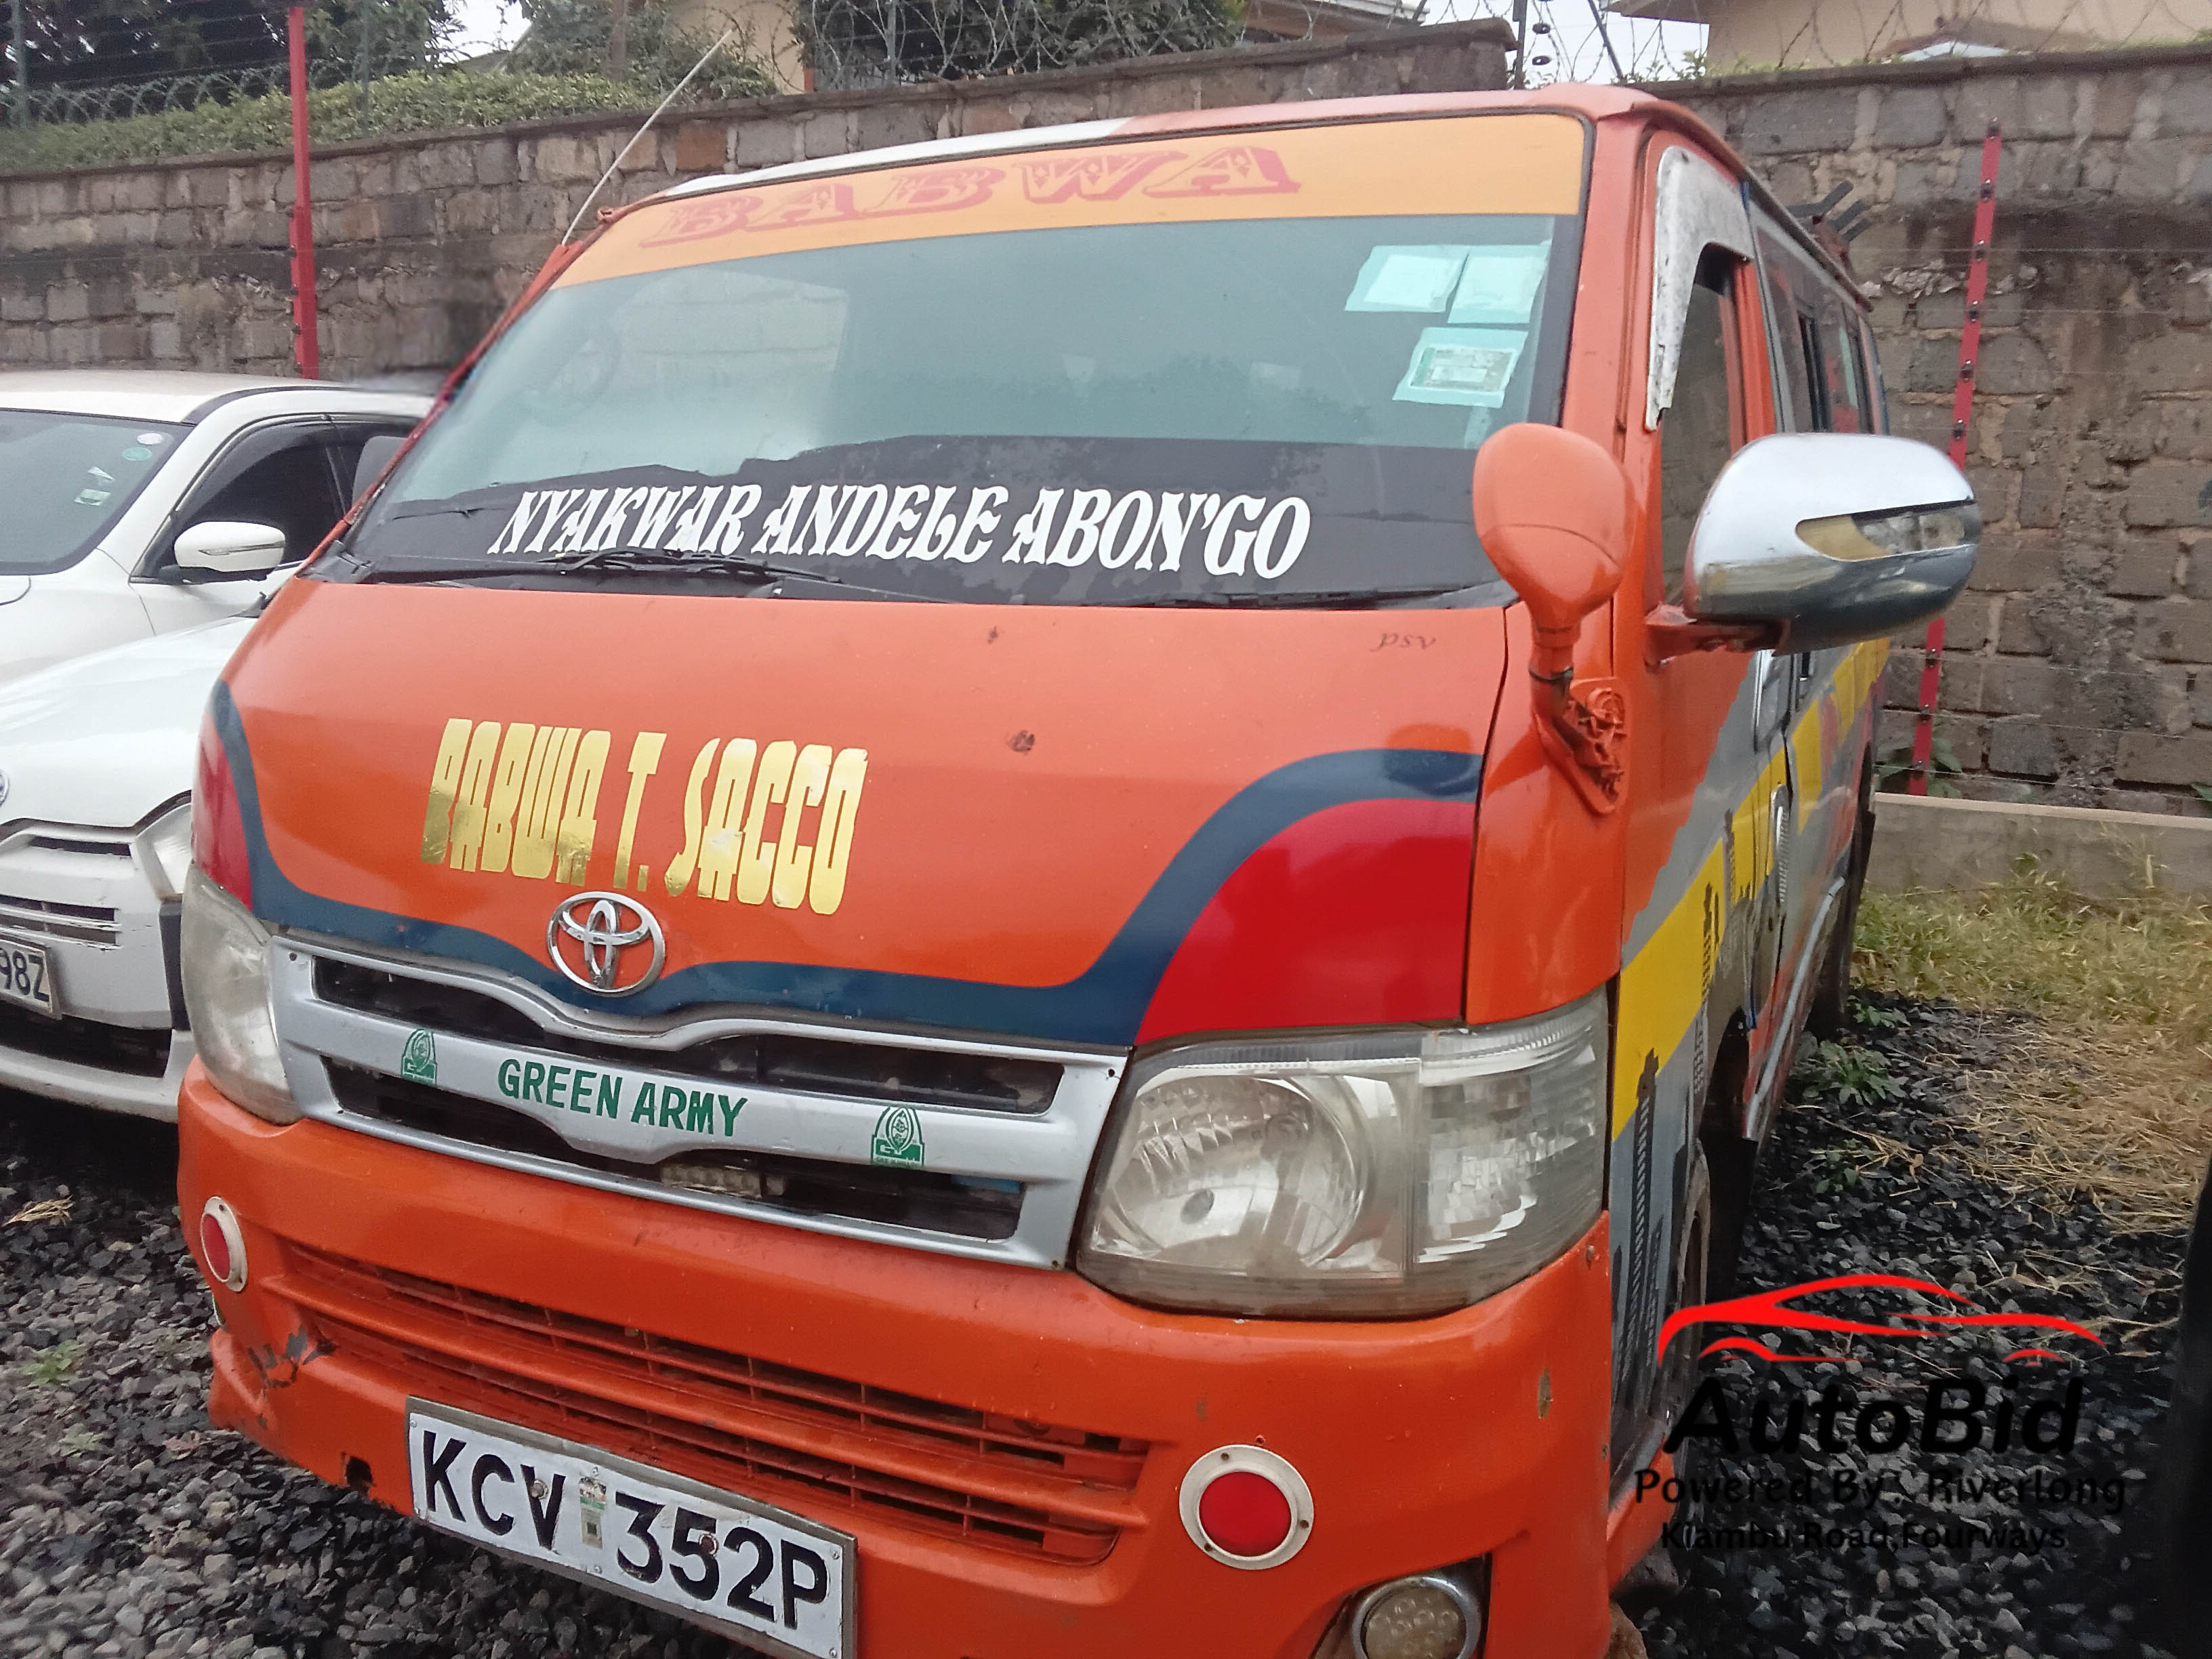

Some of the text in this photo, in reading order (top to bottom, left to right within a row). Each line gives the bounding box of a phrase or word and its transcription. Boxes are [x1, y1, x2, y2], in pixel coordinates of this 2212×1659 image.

[640, 146, 1301, 249] BABWA
[487, 483, 1311, 579] NYAKWAR ANDELE ABON'GO
[420, 718, 868, 916] BABWA T. SACCO
[498, 1059, 623, 1120] GREEN
[630, 1081, 748, 1136] ARMY
[422, 1430, 567, 1555] KCV
[615, 1490, 828, 1631] 352P
